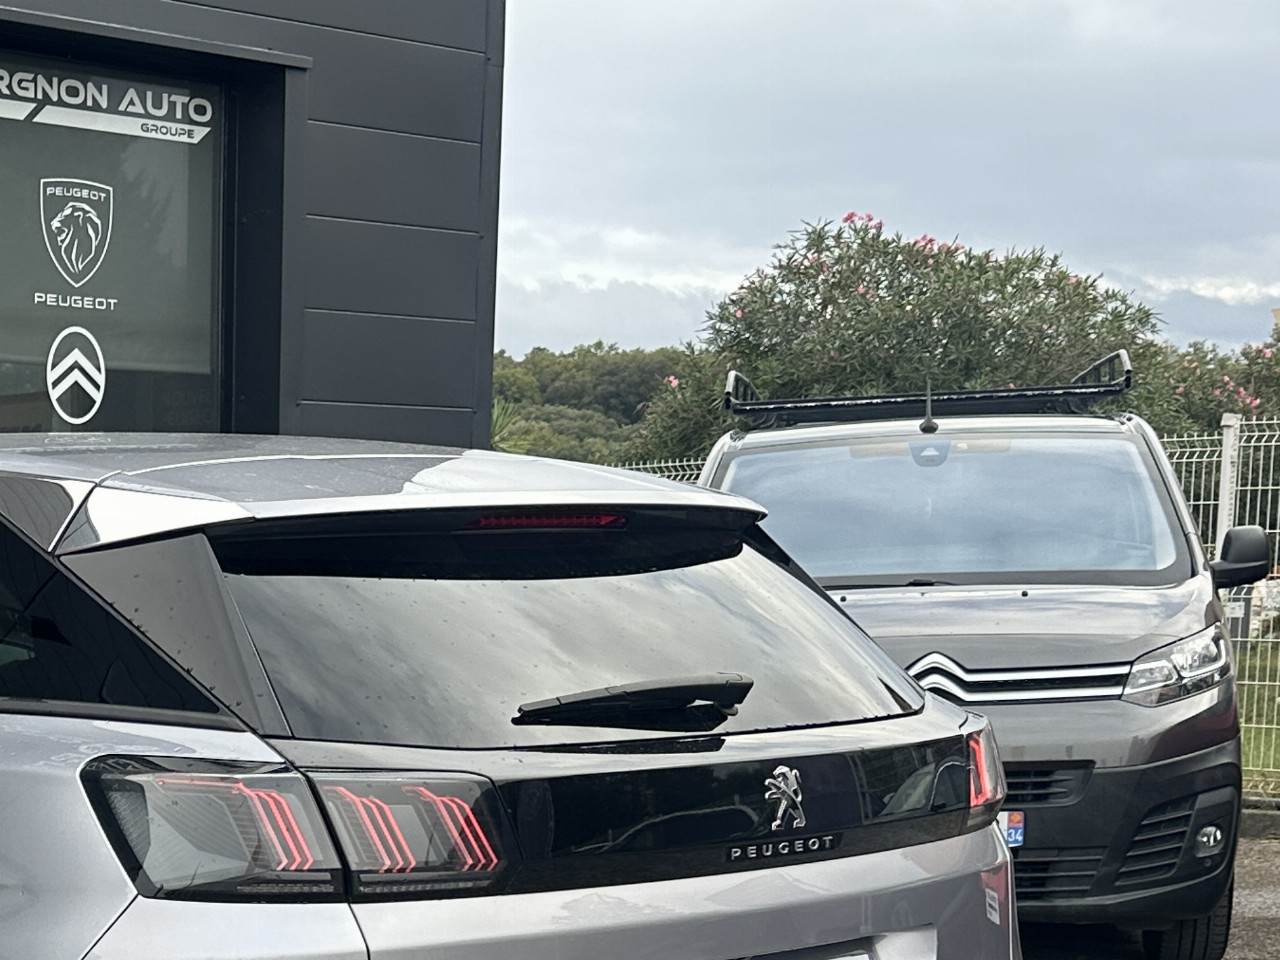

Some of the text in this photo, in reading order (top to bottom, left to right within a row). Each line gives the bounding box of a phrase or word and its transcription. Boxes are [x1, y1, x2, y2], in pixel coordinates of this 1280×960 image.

[118, 87, 213, 123] AUTO
[140, 122, 196, 140] GROUPE
[46, 186, 107, 202] PEUGEOT
[34, 292, 118, 311] PEUGEOT
[1008, 829, 1023, 842] 34
[730, 835, 834, 861] PEUGEOT
